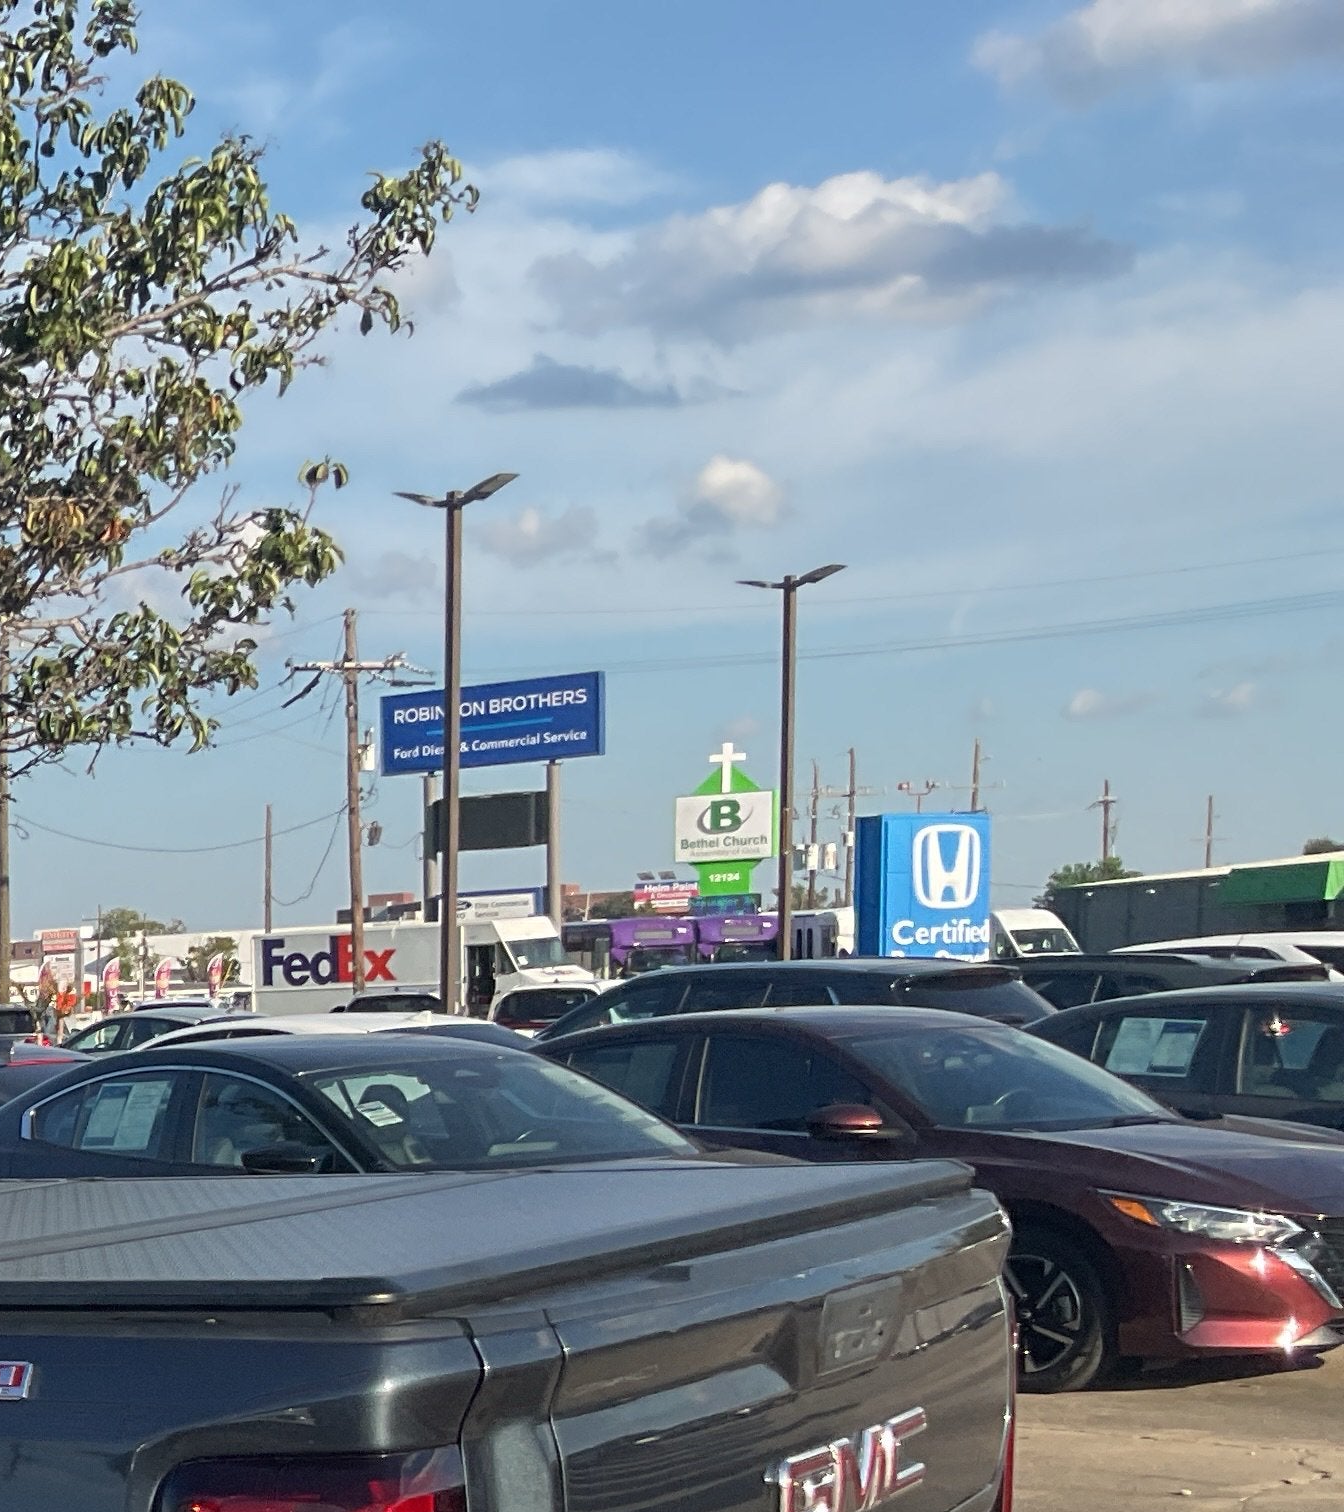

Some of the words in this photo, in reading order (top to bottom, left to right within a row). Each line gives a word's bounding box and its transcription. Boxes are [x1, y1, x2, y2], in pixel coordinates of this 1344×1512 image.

[393, 700, 485, 724] ROBINON
[488, 688, 587, 714] BROTHERS
[393, 746, 420, 760] Ford
[422, 744, 445, 757] Dies
[459, 741, 470, 752] &
[471, 733, 540, 752] Commercial
[543, 729, 587, 744] Service
[710, 799, 742, 832] B
[680, 836, 720, 850] Bethel
[723, 835, 768, 848] Church
[892, 918, 990, 945] Certified
[262, 933, 397, 986] FedEx
